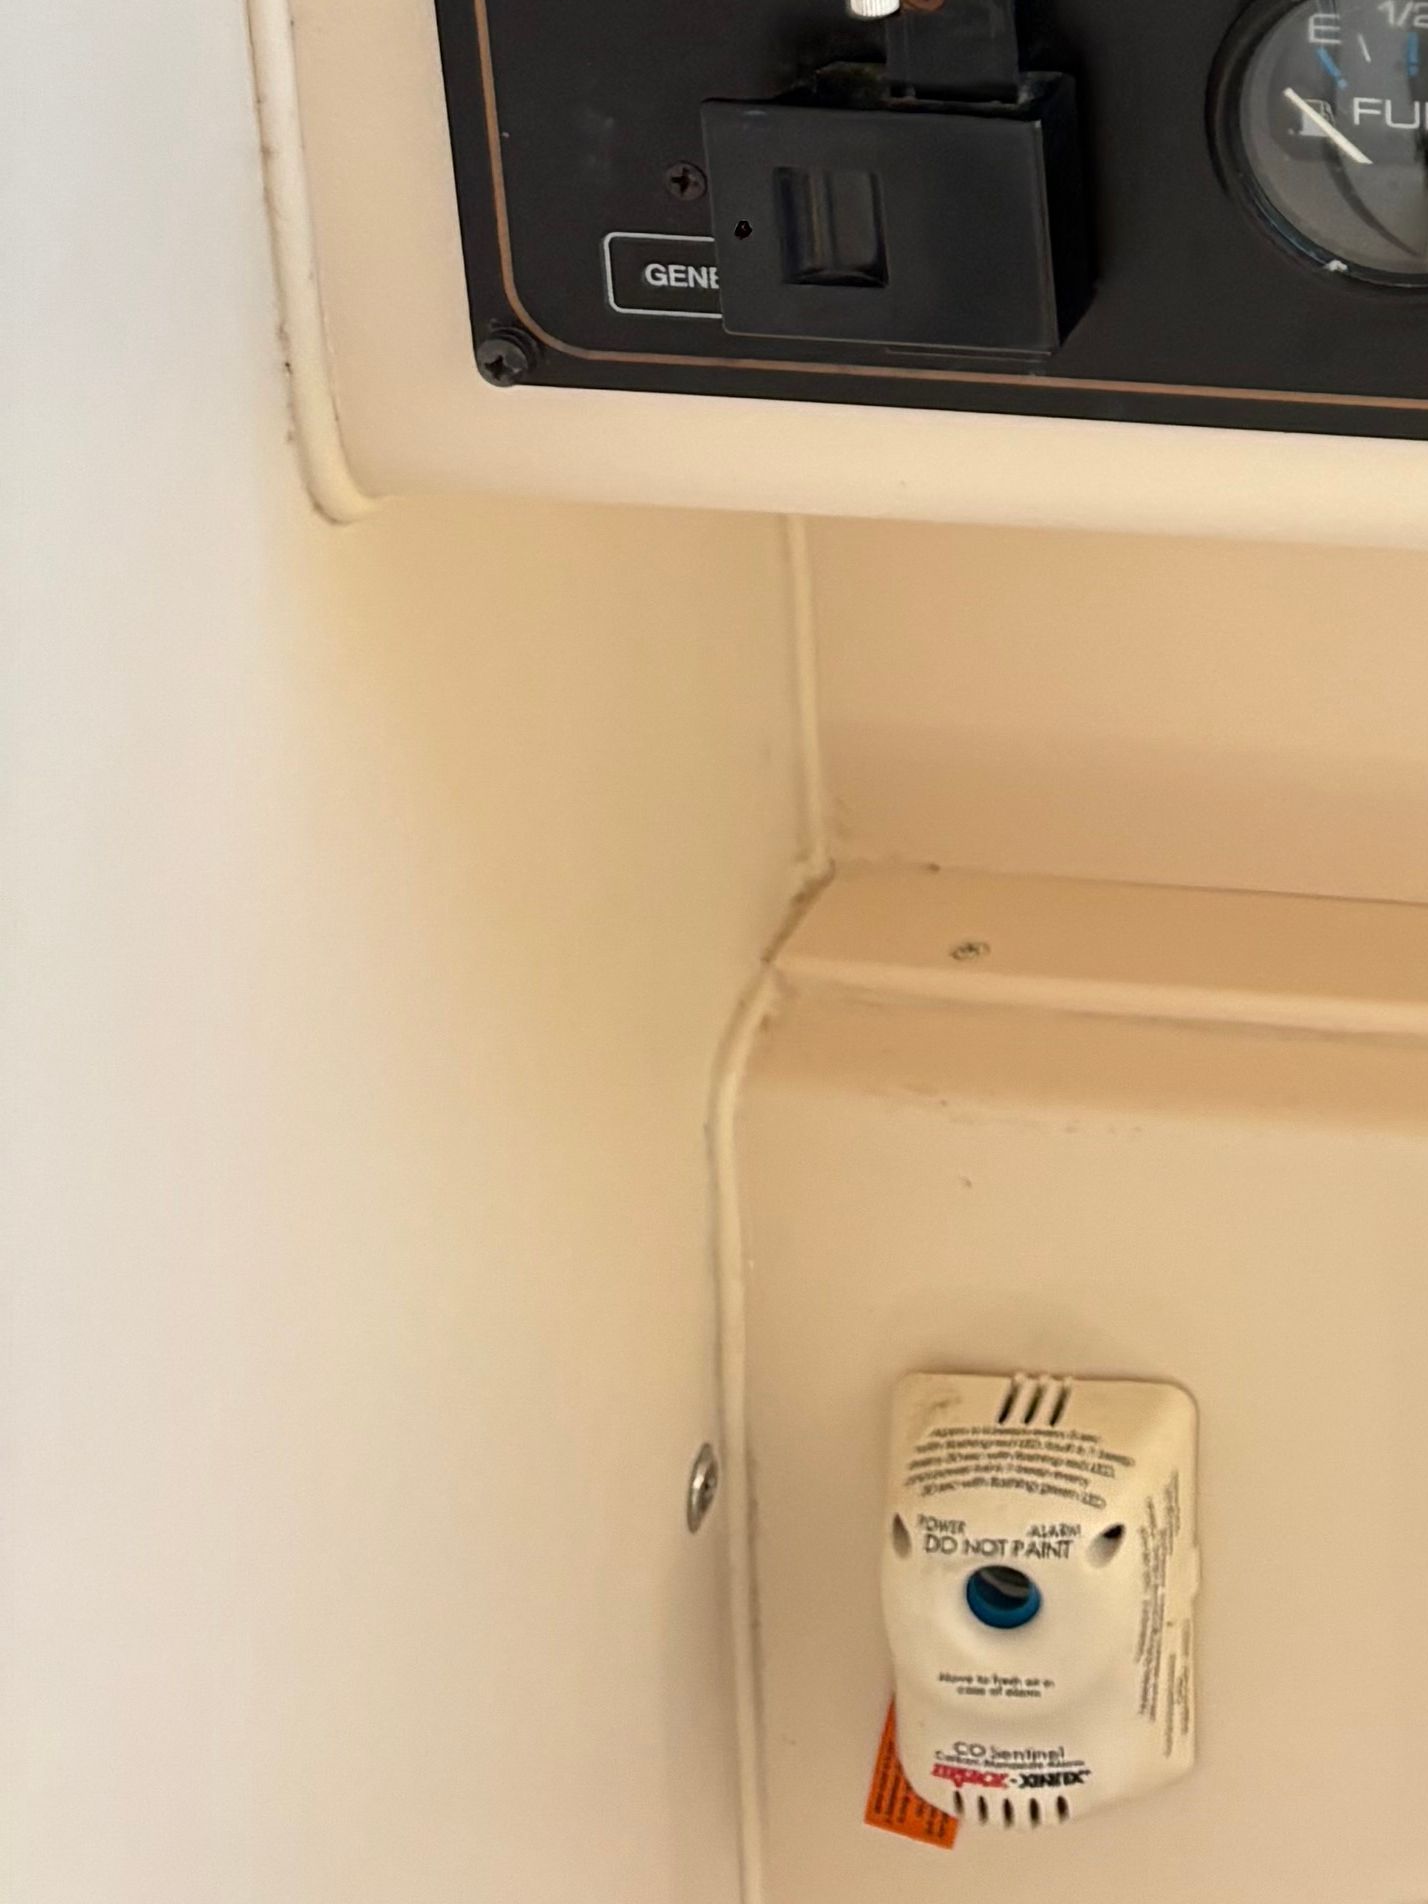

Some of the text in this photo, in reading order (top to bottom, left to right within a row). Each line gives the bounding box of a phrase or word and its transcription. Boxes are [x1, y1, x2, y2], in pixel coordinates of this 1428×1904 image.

[1308, 13, 1341, 44] E
[925, 1533, 1072, 1559] DO NOT PAINT
